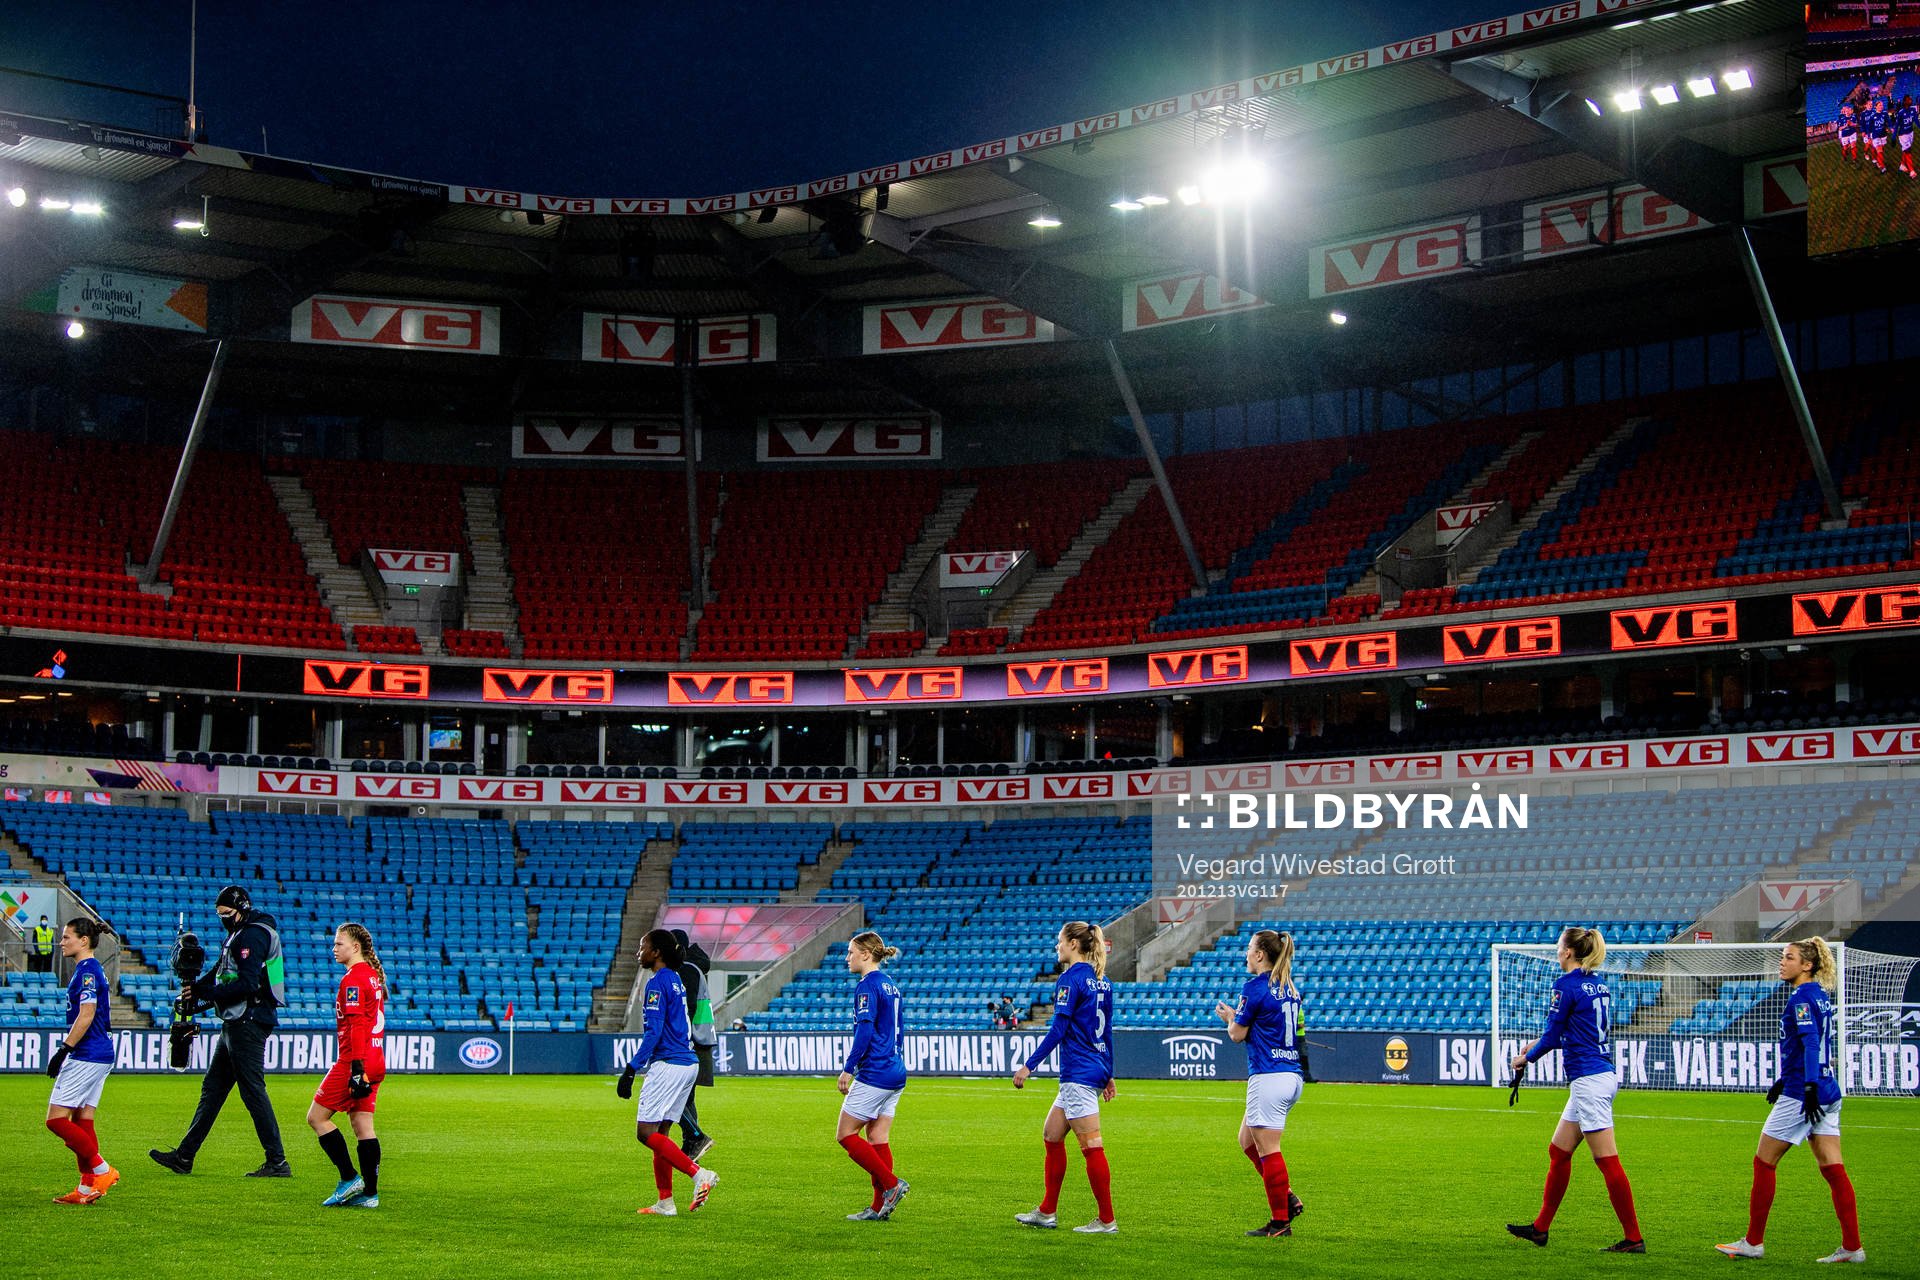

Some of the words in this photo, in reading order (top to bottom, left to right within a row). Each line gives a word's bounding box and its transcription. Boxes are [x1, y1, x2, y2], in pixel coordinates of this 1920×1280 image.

[466, 189, 517, 206] VG
[539, 198, 591, 212] VG
[612, 200, 666, 213] VG
[690, 197, 733, 213] VG
[752, 188, 795, 206] VG
[810, 177, 846, 195] VG
[859, 166, 896, 185] VG
[912, 154, 948, 173] VG
[964, 142, 1003, 161] VG
[1020, 131, 1058, 148] VG
[1075, 115, 1116, 135] VG
[1132, 101, 1175, 121] VG
[1255, 71, 1300, 91] VG
[1319, 54, 1365, 75] VG
[1387, 37, 1434, 60] VG
[1456, 21, 1503, 44] VG
[1525, 6, 1577, 27] VG
[1545, 194, 1690, 244] VG
[1328, 229, 1461, 286] VG
[82, 278, 133, 303] drømmen
[101, 273, 112, 287] Gi
[92, 301, 103, 311] en
[105, 301, 142, 320] sjanse!
[317, 302, 472, 346] VG
[886, 303, 1027, 344] VG
[607, 322, 750, 359] VG
[528, 420, 681, 454] VG
[774, 420, 922, 454] VG
[380, 552, 446, 571] VG
[310, 664, 421, 693] VG
[489, 672, 604, 701] VG
[672, 675, 785, 703] VG
[849, 669, 956, 701] VG
[1010, 663, 1103, 694] VG
[1152, 650, 1242, 686] VG
[1295, 638, 1390, 673] VG
[1448, 620, 1553, 660] VG
[1616, 606, 1729, 644] VG
[1796, 588, 1920, 630] VG
[262, 773, 334, 794] VG
[358, 777, 437, 797] VG
[461, 780, 539, 800] VG
[564, 782, 642, 801] VG
[668, 783, 743, 802] VG
[768, 783, 844, 802] VG
[866, 782, 937, 802] VG
[961, 779, 1026, 799] VG
[1046, 776, 1109, 797] VG
[1130, 771, 1187, 793] VG
[1207, 767, 1268, 789] VG
[1287, 761, 1351, 785] VG
[1372, 757, 1438, 780] VG
[1460, 752, 1529, 775] VG
[1551, 746, 1625, 770] VG
[1649, 741, 1724, 765] VG
[1751, 735, 1828, 760] VG
[1095, 993, 1106, 1039] 5
[1282, 1001, 1298, 1047] 11
[744, 1036, 853, 1072] VELKOMMEN
[903, 1036, 1006, 1073] UPFINALEN
[1166, 1037, 1218, 1060] THON
[1386, 1050, 1408, 1059] LSK
[1440, 1039, 1486, 1081] LSK
[1615, 1040, 1648, 1083] FK
[1672, 1038, 1781, 1087] VÅLERE
[1846, 1044, 1919, 1089] FOTB
[1170, 1063, 1216, 1077] HOTELS
[1382, 1073, 1401, 1081] Kvinner
[1402, 1073, 1410, 1081] FK
